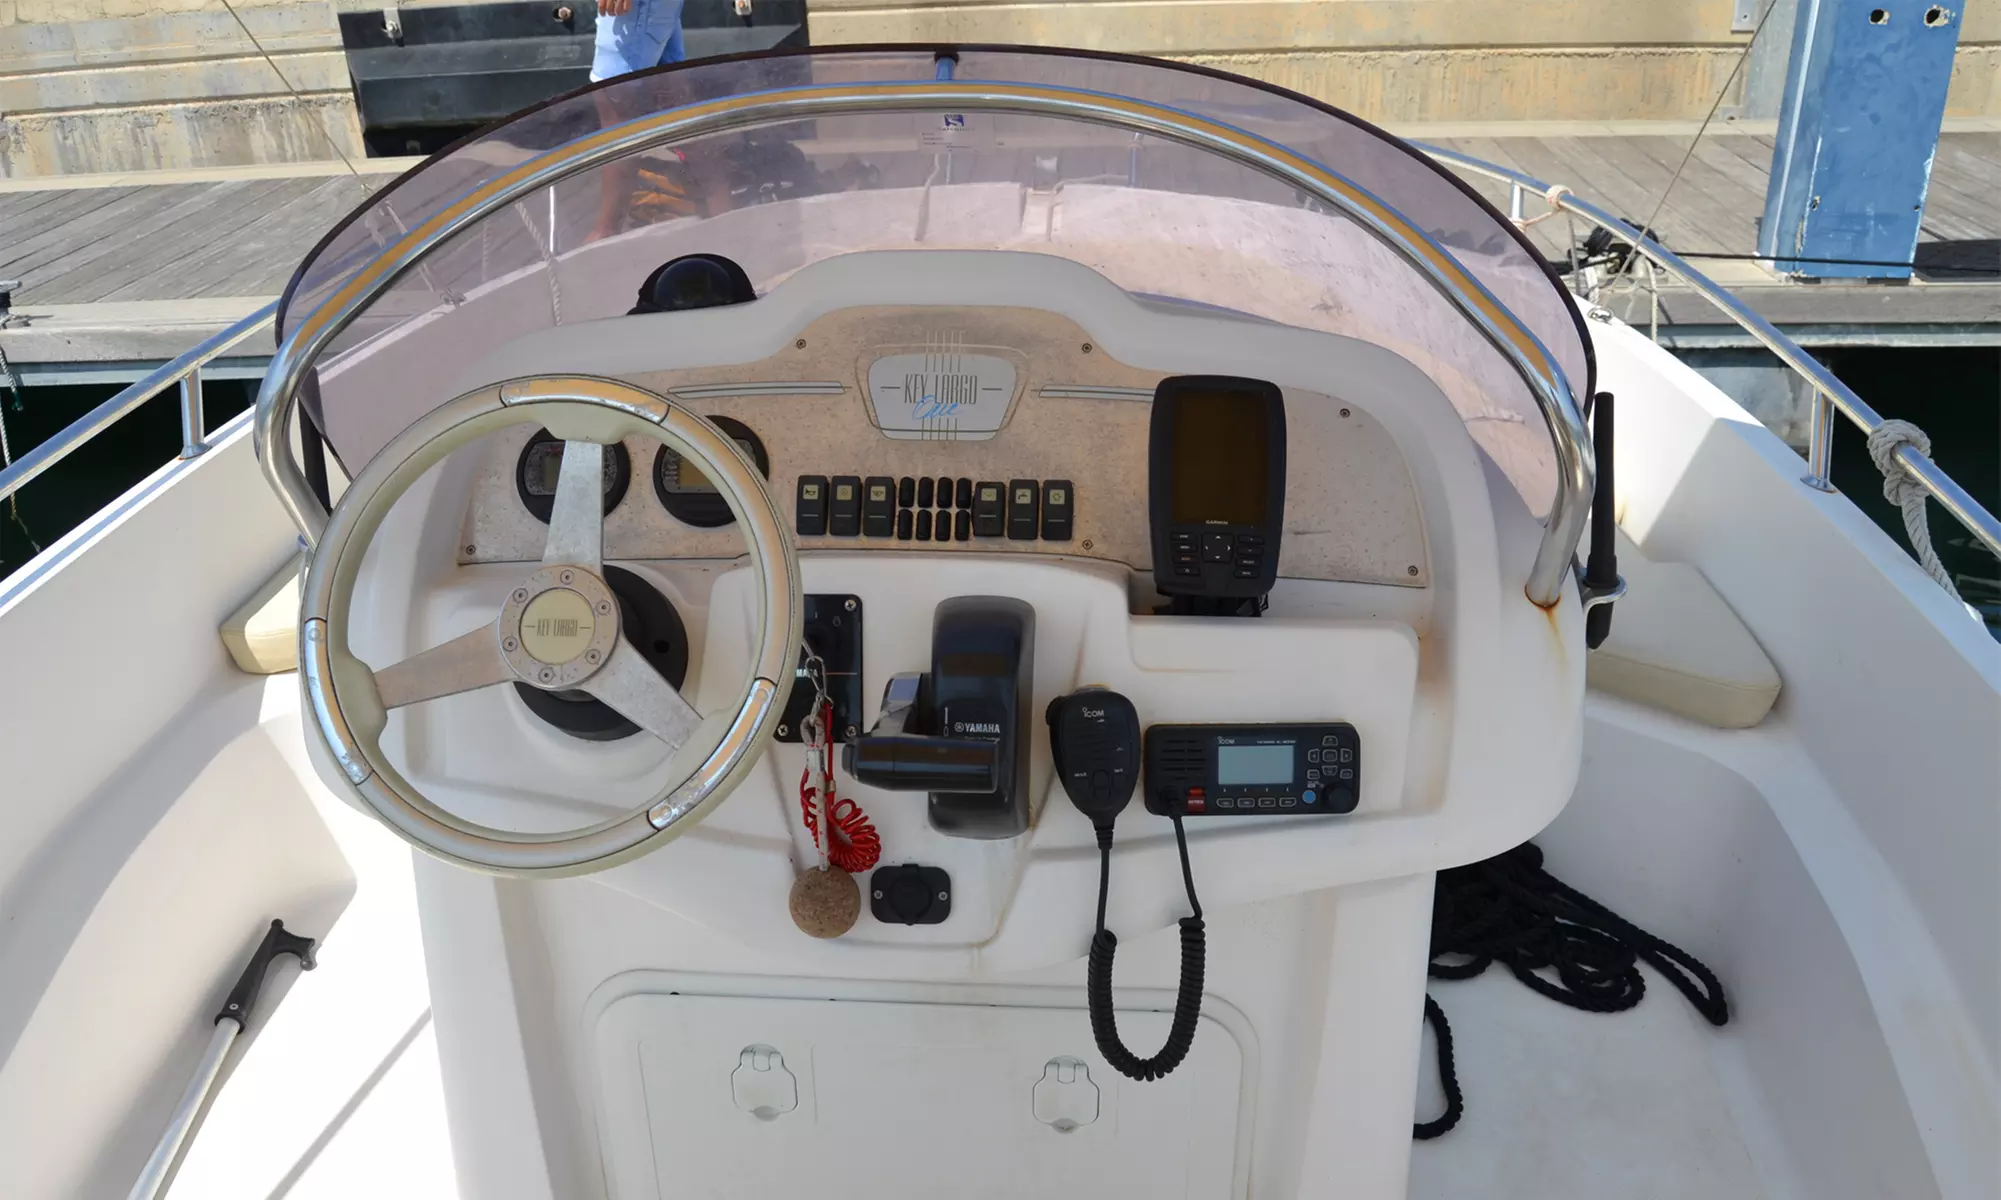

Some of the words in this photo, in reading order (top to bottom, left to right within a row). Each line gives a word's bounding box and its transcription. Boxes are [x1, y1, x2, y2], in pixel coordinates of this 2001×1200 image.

[904, 373, 928, 404] KEY
[934, 374, 978, 405] LARGO
[536, 619, 550, 636] KEY
[553, 619, 578, 637] LARGO
[964, 722, 1001, 734] YAMAHA
